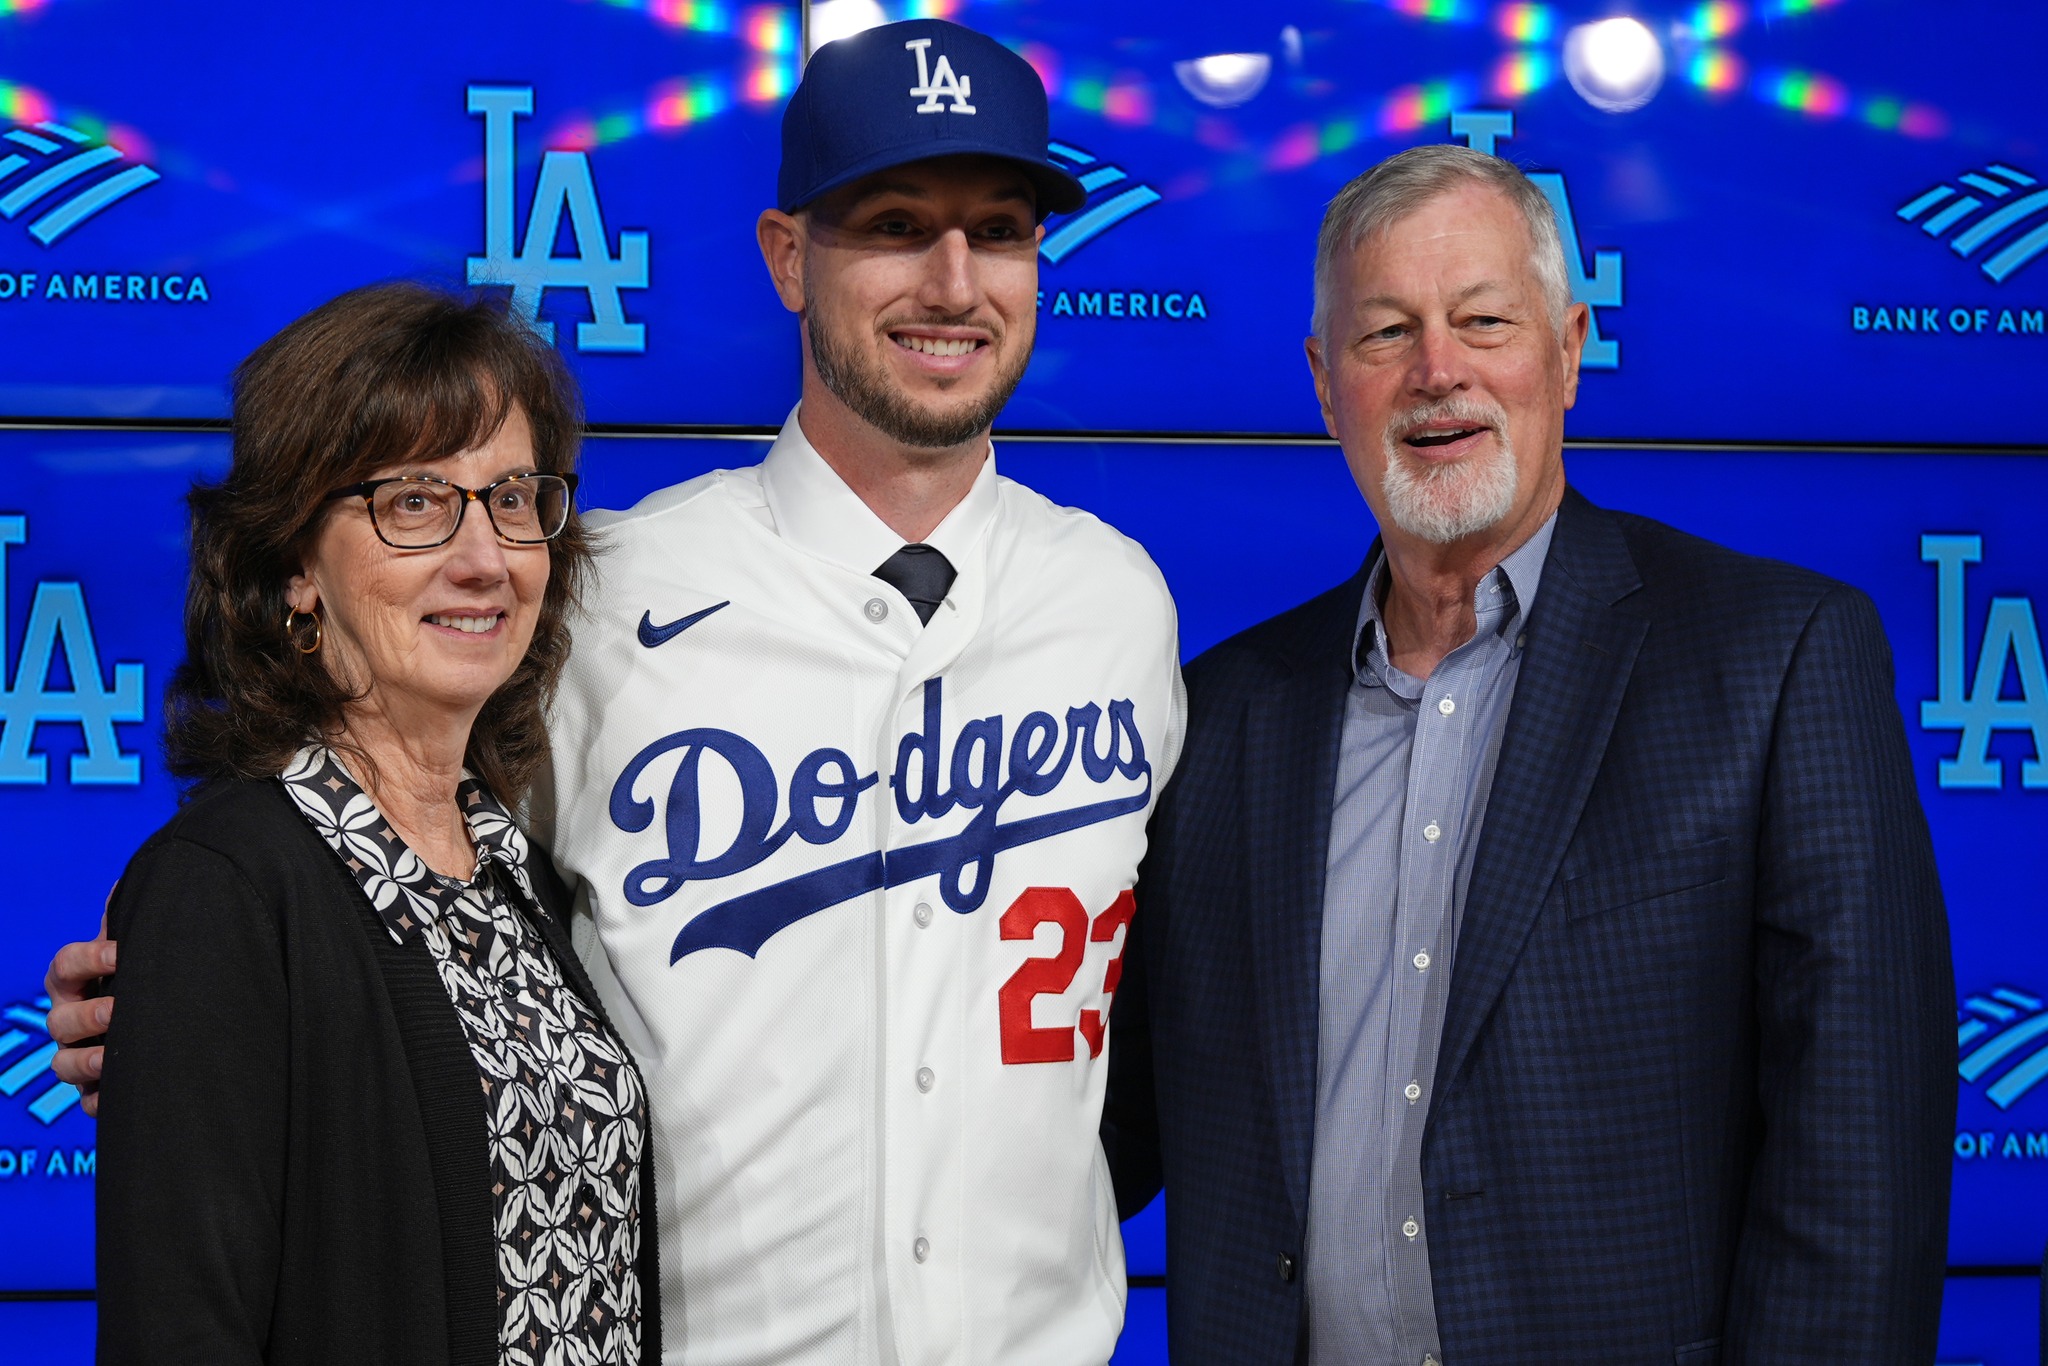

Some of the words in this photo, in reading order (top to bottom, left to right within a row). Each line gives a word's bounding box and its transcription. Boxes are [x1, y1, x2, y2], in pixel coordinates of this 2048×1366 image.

[905, 38, 976, 115] LA
[467, 85, 649, 352] LA
[0, 273, 37, 298] OF
[46, 274, 209, 301] AMERICA
[1053, 291, 1207, 319] AMERICA
[1853, 306, 1941, 332] BANK
[1949, 308, 1990, 333] OF
[609, 676, 1152, 915] Dodgers
[998, 886, 1137, 1065] 23
[1953, 1132, 1994, 1159] OF
[0, 1149, 37, 1176] OF
